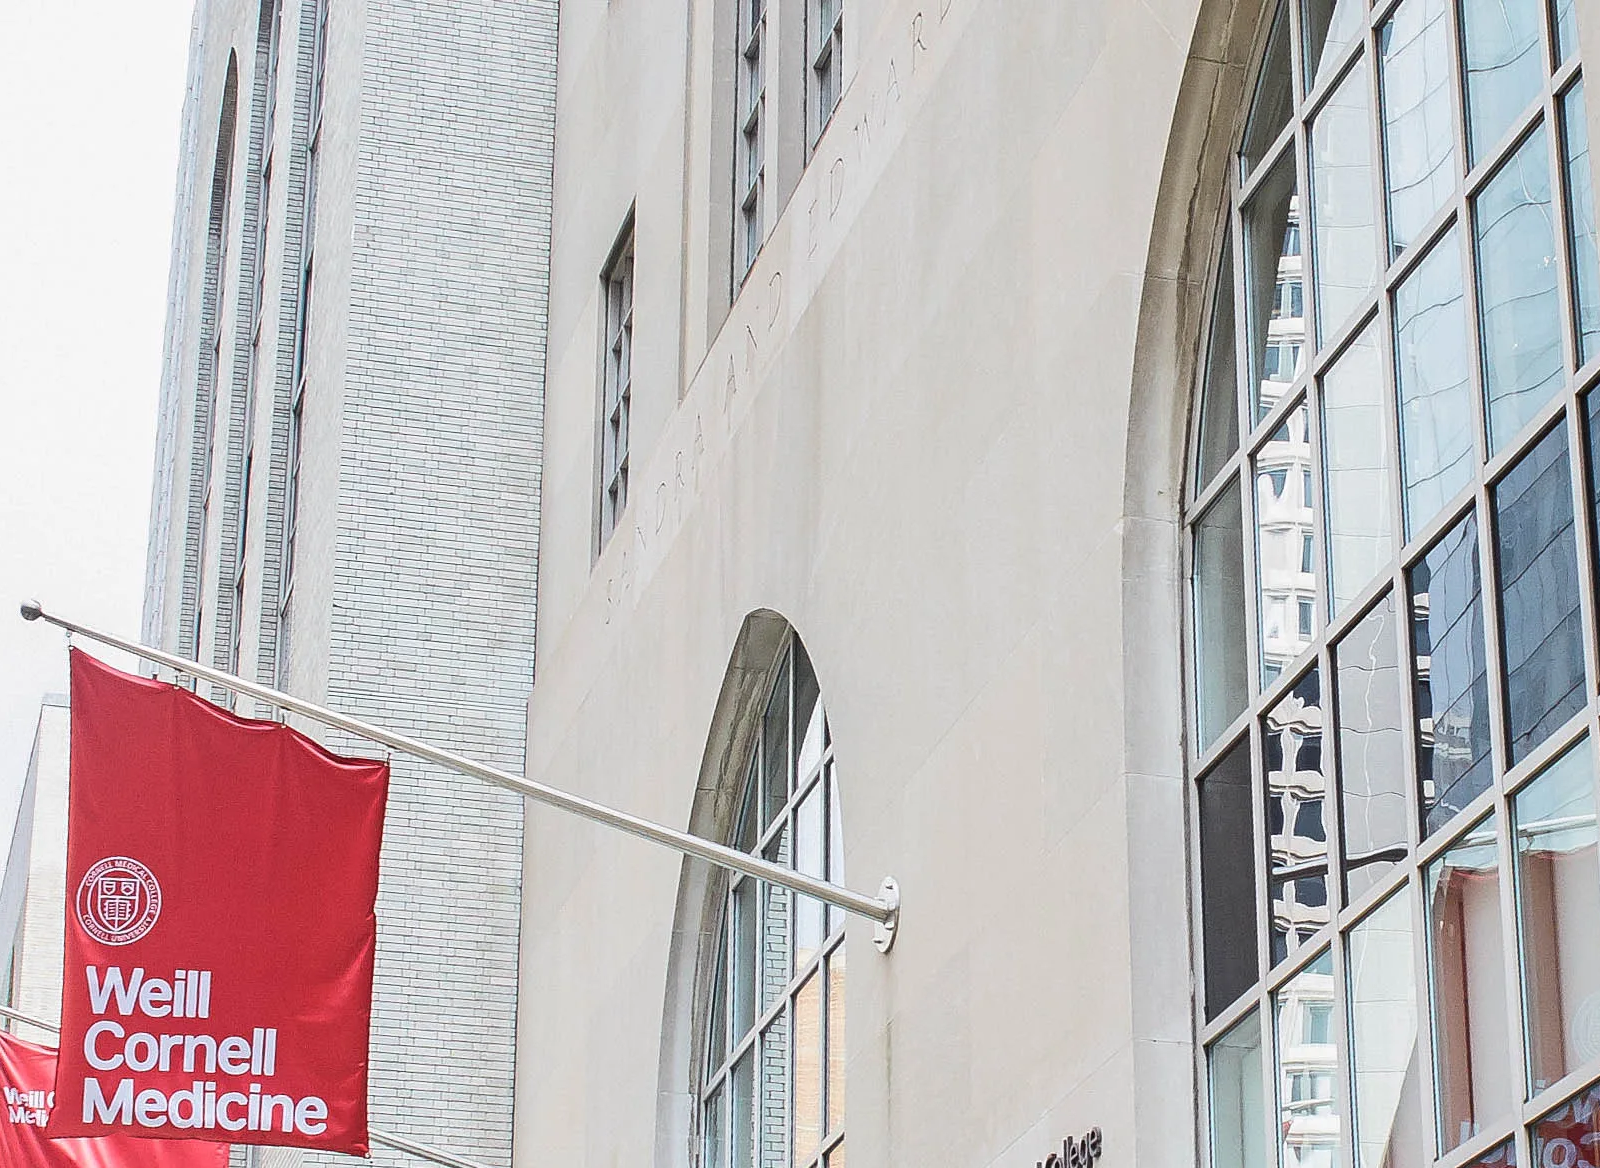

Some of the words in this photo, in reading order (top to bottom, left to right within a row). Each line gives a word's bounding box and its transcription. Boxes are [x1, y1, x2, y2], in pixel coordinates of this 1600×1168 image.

[85, 966, 211, 1019] Weill
[84, 1020, 277, 1076] Cornell
[82, 1077, 328, 1135] Medicine
